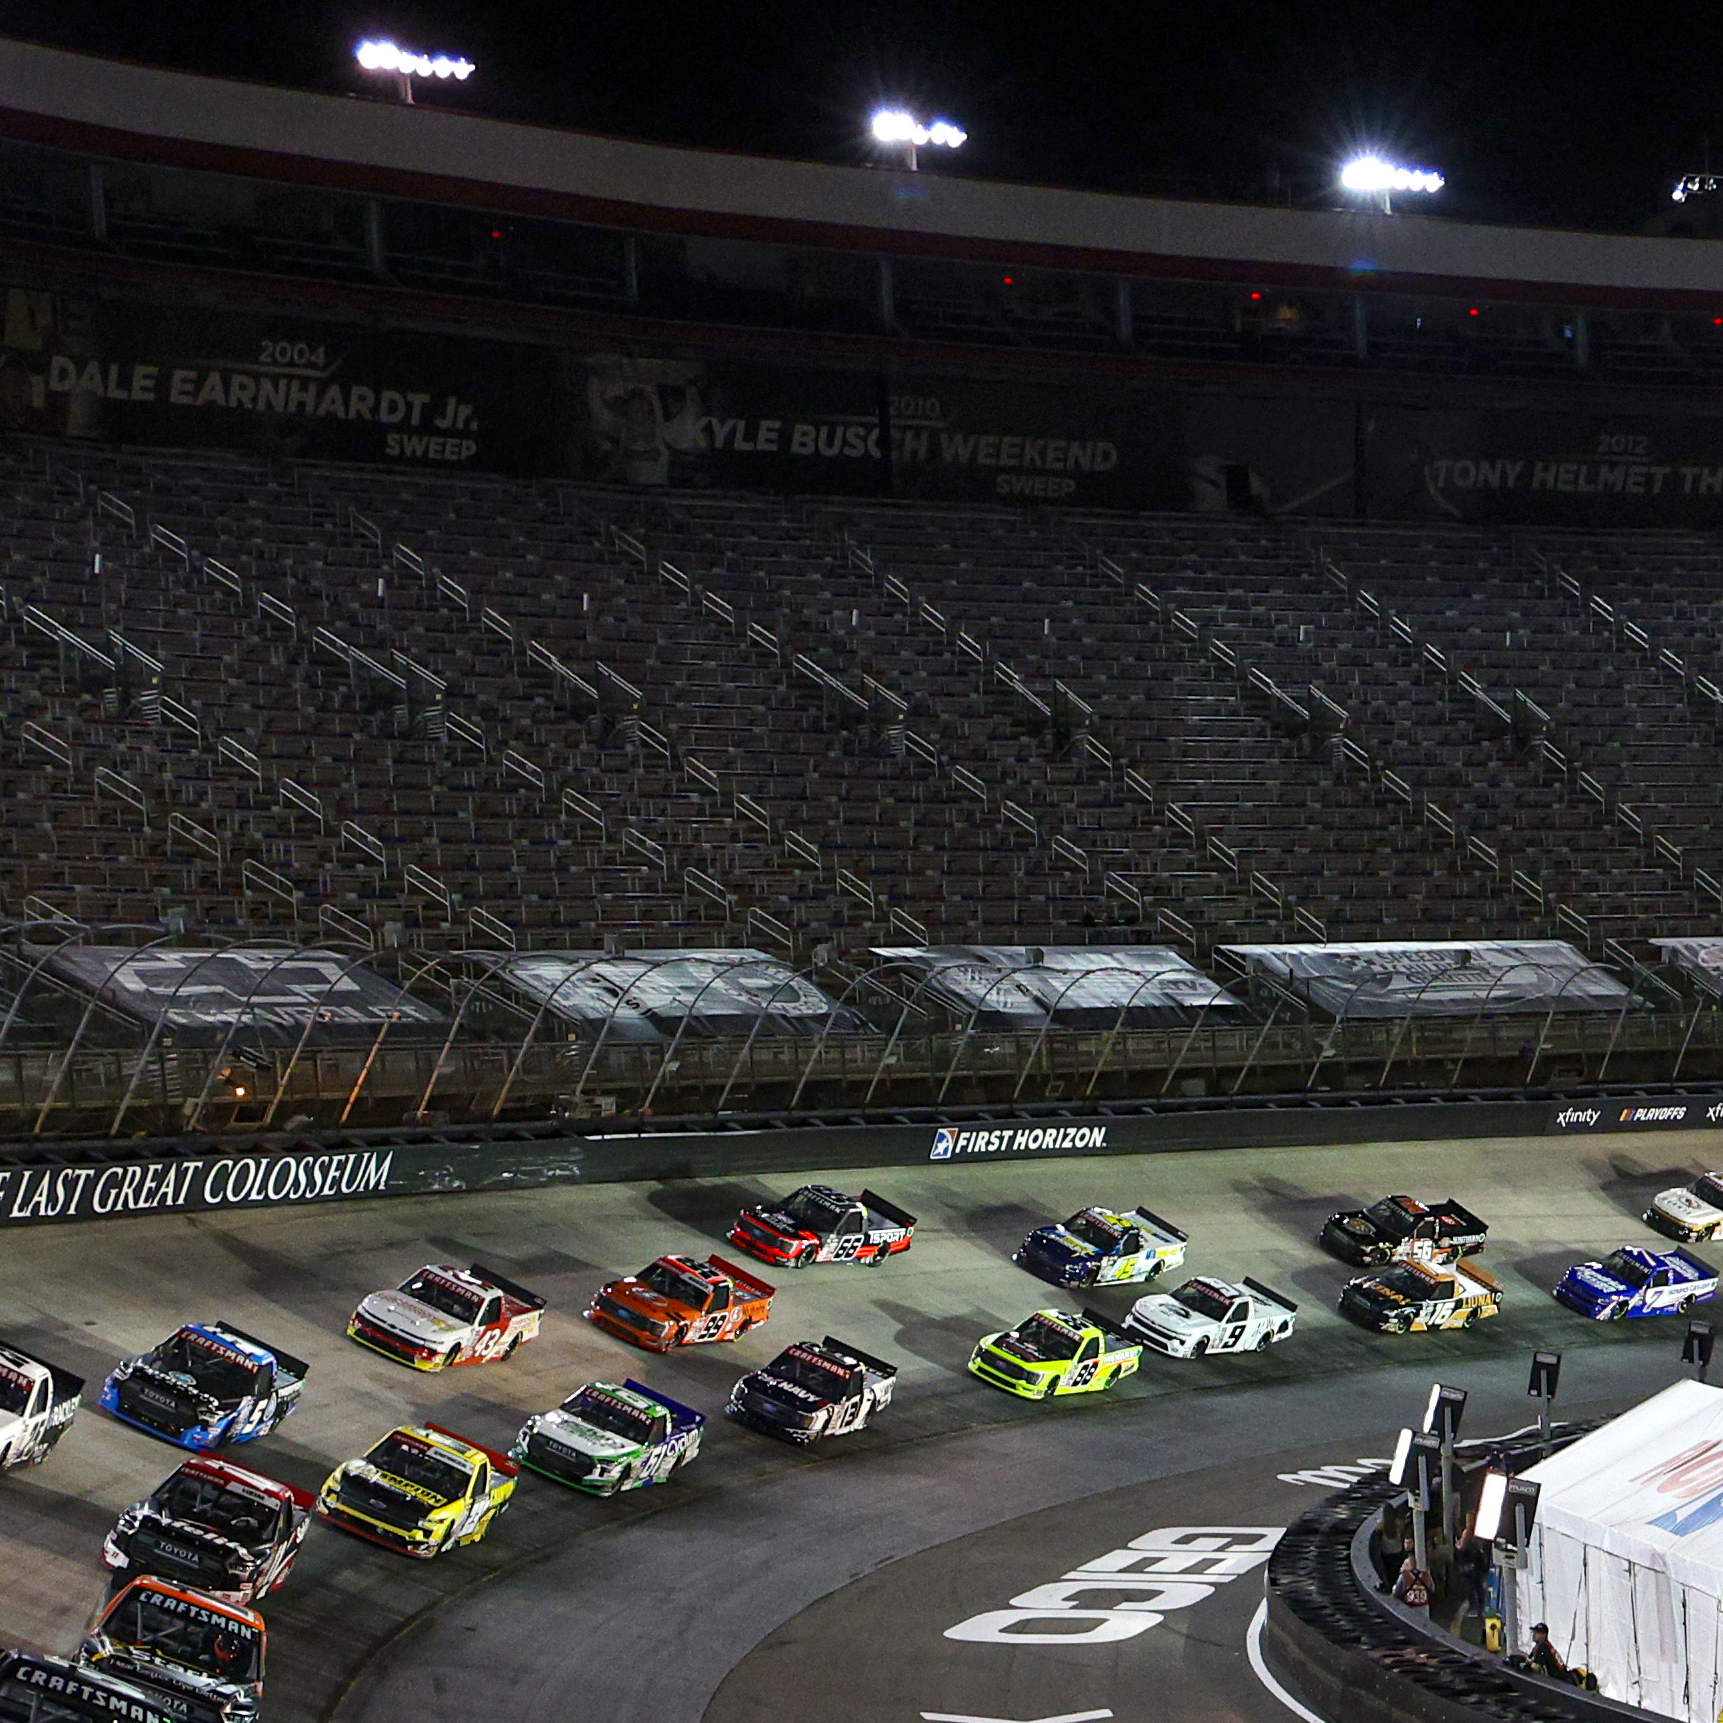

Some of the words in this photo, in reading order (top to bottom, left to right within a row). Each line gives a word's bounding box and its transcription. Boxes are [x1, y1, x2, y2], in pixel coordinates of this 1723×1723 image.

[258, 338, 328, 370] 2004
[48, 354, 158, 401] DALE
[169, 369, 431, 426] EARNHARDT
[433, 400, 479, 432] Jr.
[385, 434, 478, 462] SWEEP
[682, 416, 783, 453] KYLE
[790, 422, 929, 463] BUSCH
[940, 433, 1119, 473] WEEKEND
[1596, 433, 1649, 456] 2012
[995, 473, 1077, 498] SWEEP
[1433, 458, 1522, 489] TONY
[1529, 460, 1670, 495] HELMET
[1556, 1107, 1602, 1127] xfinity
[1632, 1106, 1688, 1122] PLAYOFFS
[955, 1130, 1012, 1154] FIRST
[1014, 1126, 1107, 1151] HORIZON
[8, 1168, 94, 1217] LAST
[93, 1159, 204, 1214] GREAT
[202, 1150, 395, 1203] COLOSSEUM
[1412, 1240, 1433, 1260] 56
[423, 1269, 481, 1302] CRAFTSMAN
[1034, 1313, 1083, 1343] CRAFTSMAN
[1427, 1301, 1455, 1326] 16
[475, 1327, 502, 1357] 43
[1222, 1323, 1246, 1349] 9
[180, 1329, 255, 1374] CRAFTSMAN
[787, 1346, 851, 1379] CRAFTSMAN
[142, 1386, 177, 1409] TOYOTA
[779, 1380, 825, 1404] NAVY
[240, 1401, 264, 1435] 5
[585, 1387, 653, 1428] CRAFTSMAN
[159, 1540, 201, 1564] TOYOTA
[943, 1525, 1288, 1644] GEICO
[1406, 1589, 1428, 1605] 939
[138, 1589, 253, 1641] CRAFTSMAN
